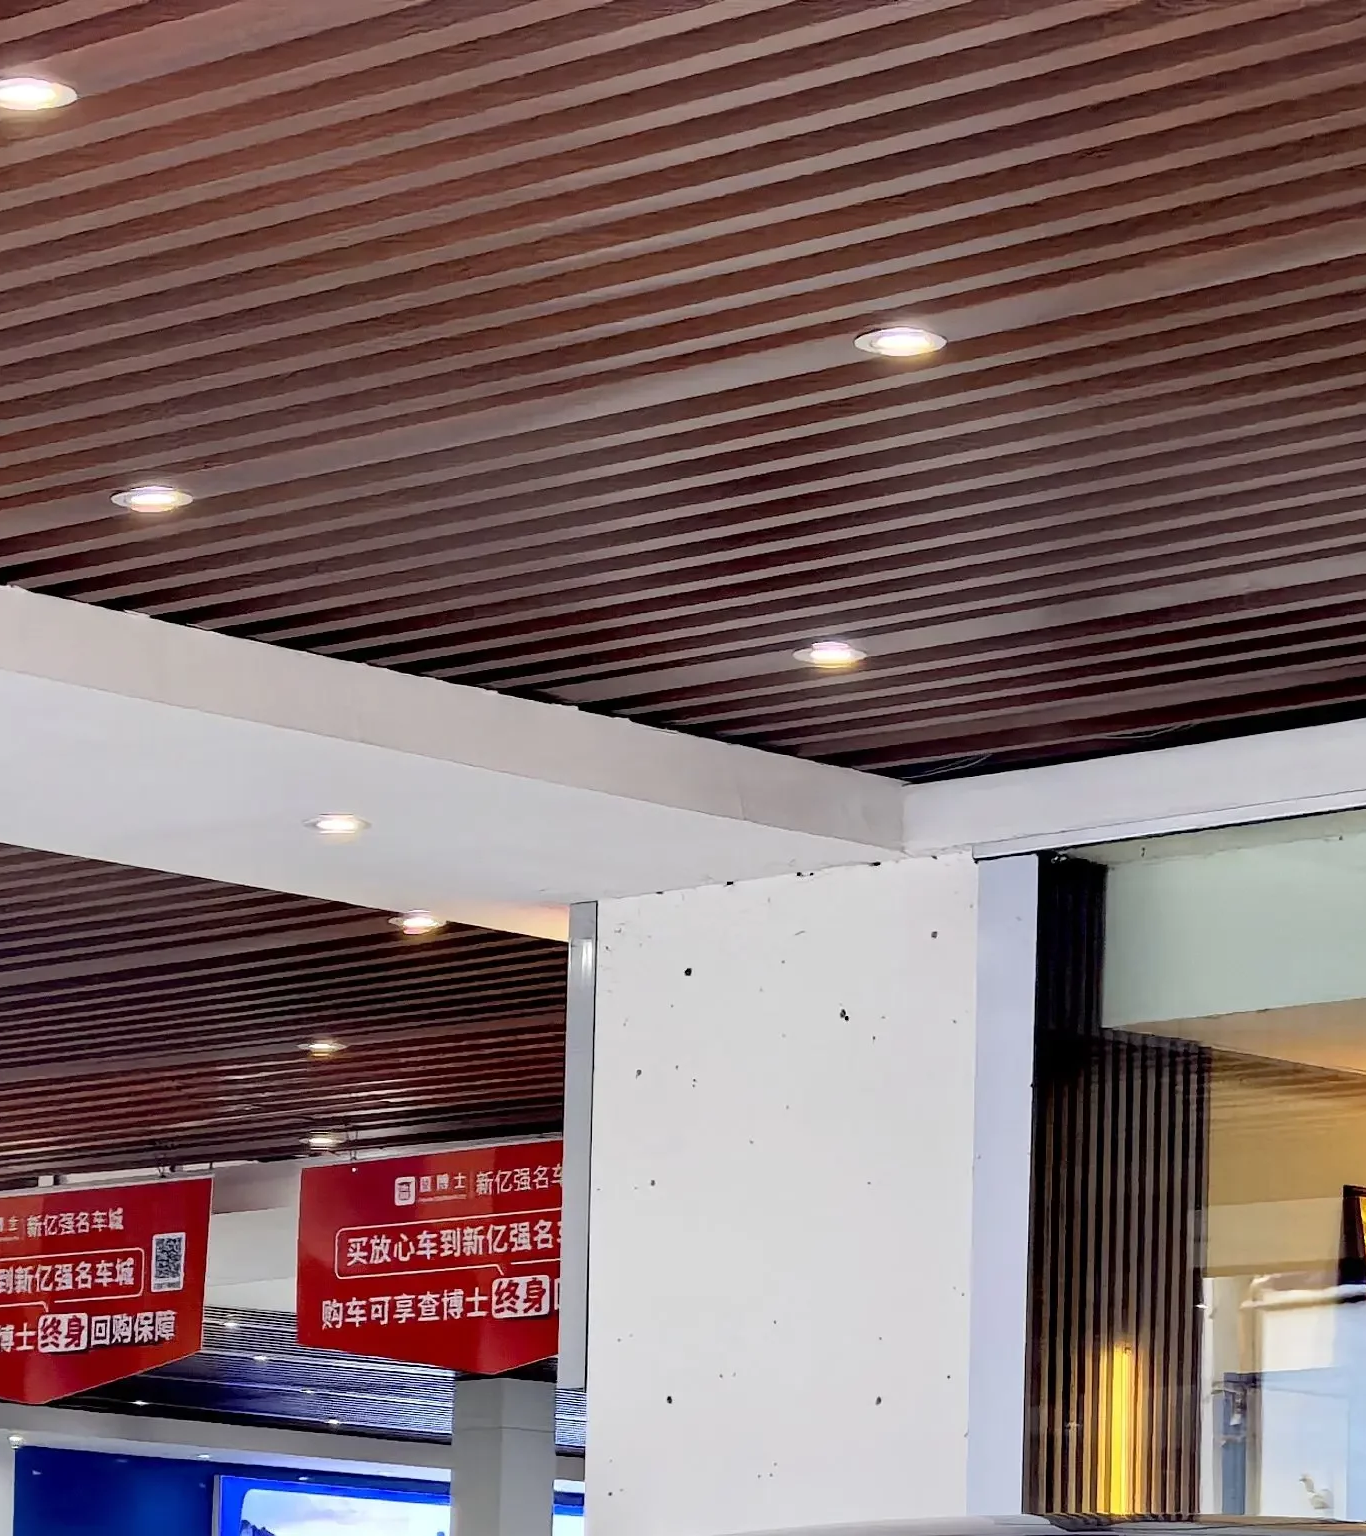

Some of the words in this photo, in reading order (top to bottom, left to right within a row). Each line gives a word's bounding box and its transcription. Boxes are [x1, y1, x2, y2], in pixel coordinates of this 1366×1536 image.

[26, 1207, 125, 1239] 新亿强名车城
[346, 1219, 562, 1267] 买放心车到新亿强名
